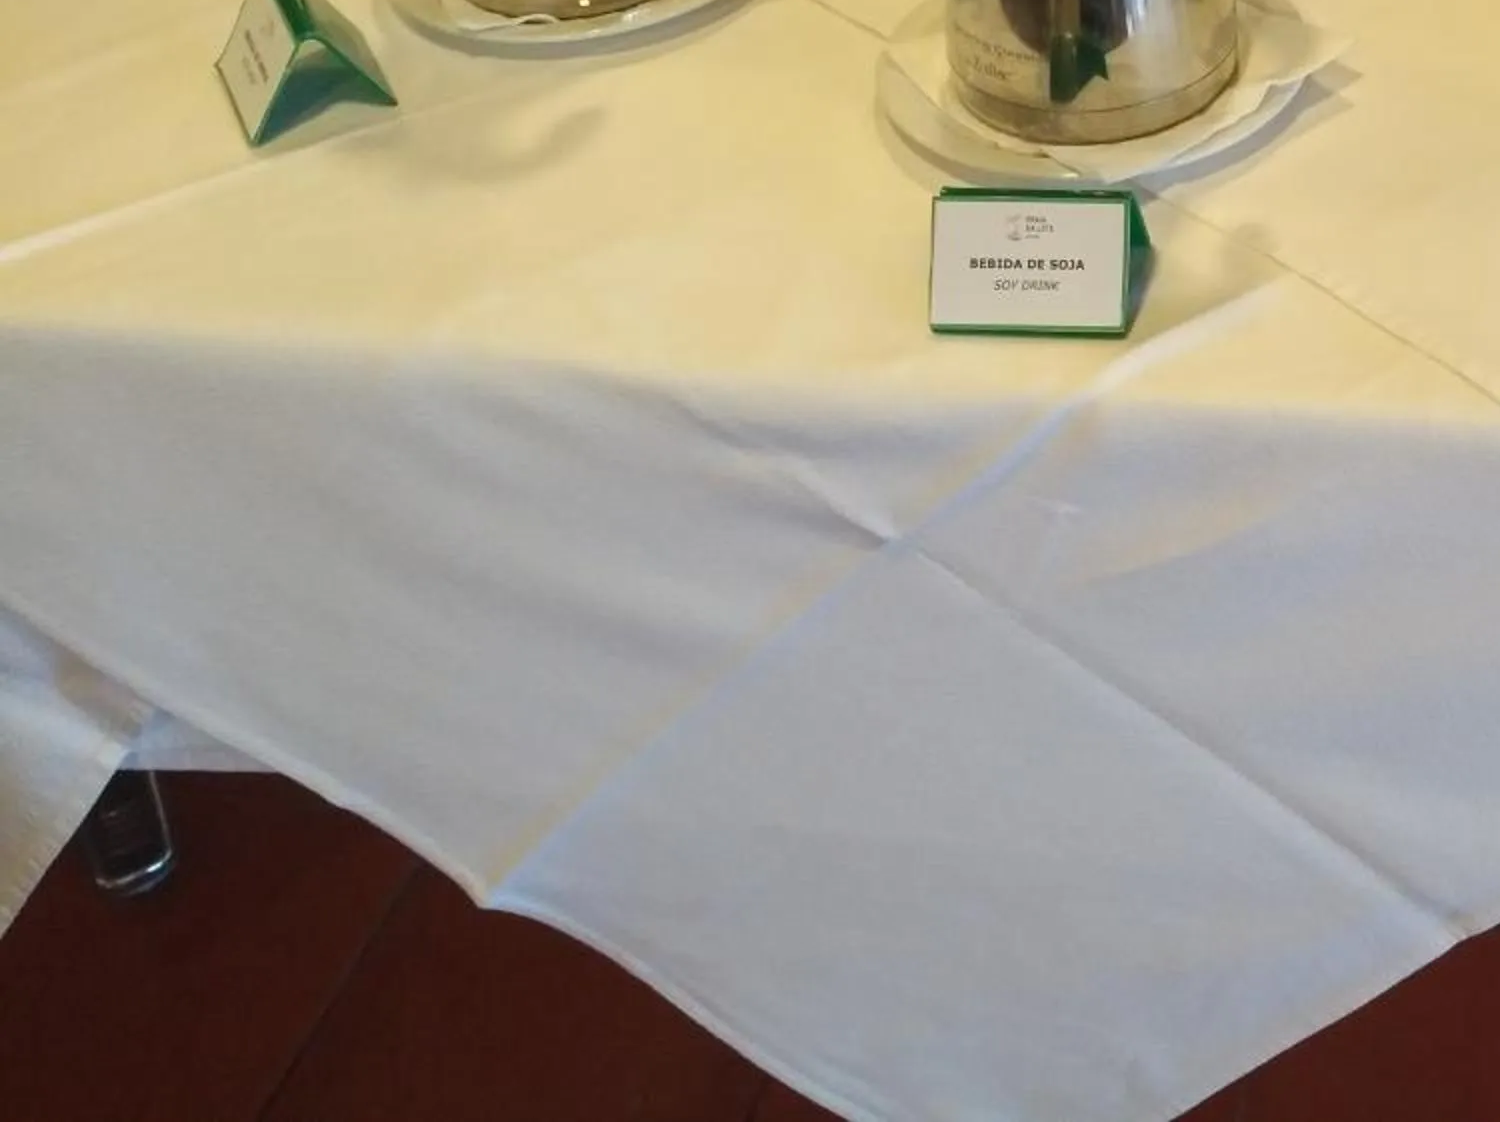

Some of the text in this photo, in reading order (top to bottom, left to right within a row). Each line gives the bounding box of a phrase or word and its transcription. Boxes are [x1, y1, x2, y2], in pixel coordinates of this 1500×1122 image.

[969, 258, 1085, 271] BEBIDA DE SOJA
[994, 279, 1061, 291] SOY DRINK
